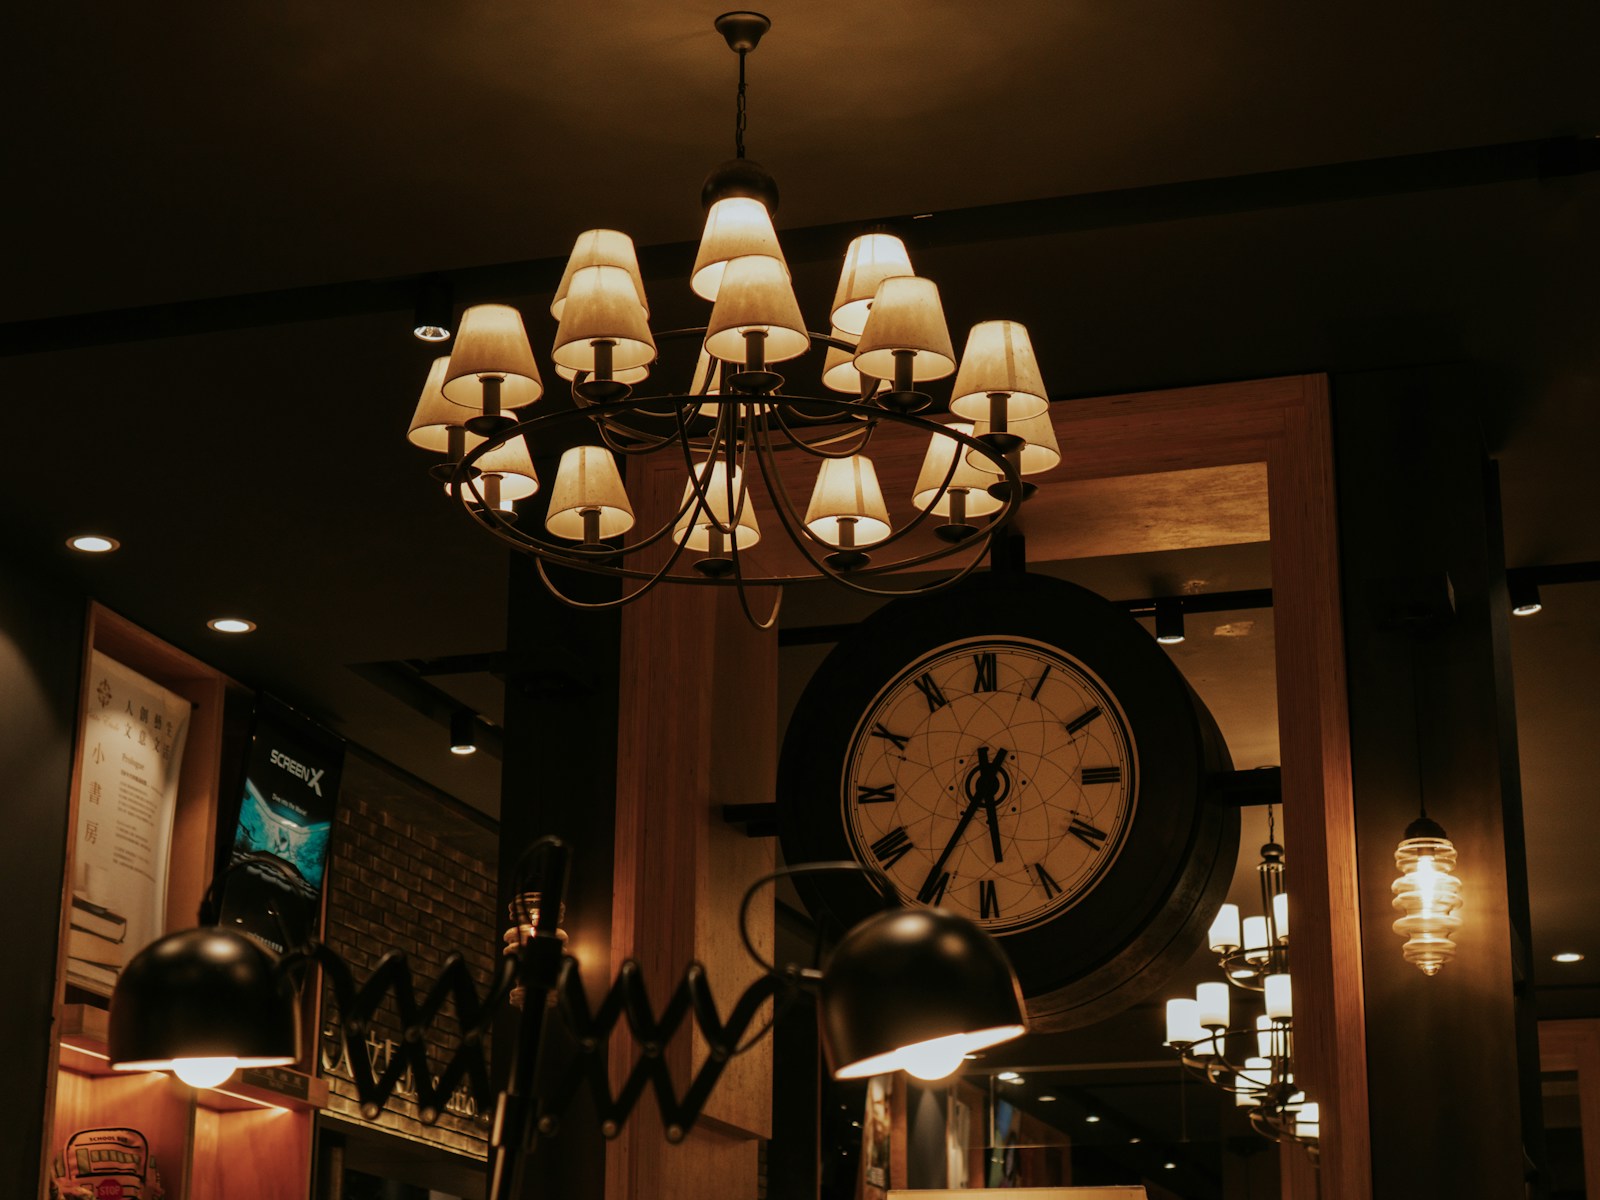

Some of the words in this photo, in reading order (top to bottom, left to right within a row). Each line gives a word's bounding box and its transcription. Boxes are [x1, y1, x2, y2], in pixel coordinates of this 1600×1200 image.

[973, 653, 997, 693] XII
[1031, 665, 1051, 700] I
[914, 672, 947, 713] XI
[871, 722, 909, 750] X
[1066, 705, 1102, 734] II
[1081, 766, 1121, 785] III
[858, 784, 895, 804] IX
[870, 826, 914, 871] VIII
[1068, 818, 1108, 851] IV
[1034, 862, 1063, 900] V
[980, 879, 1000, 919] VI
[100, 1185, 121, 1196] STOP
